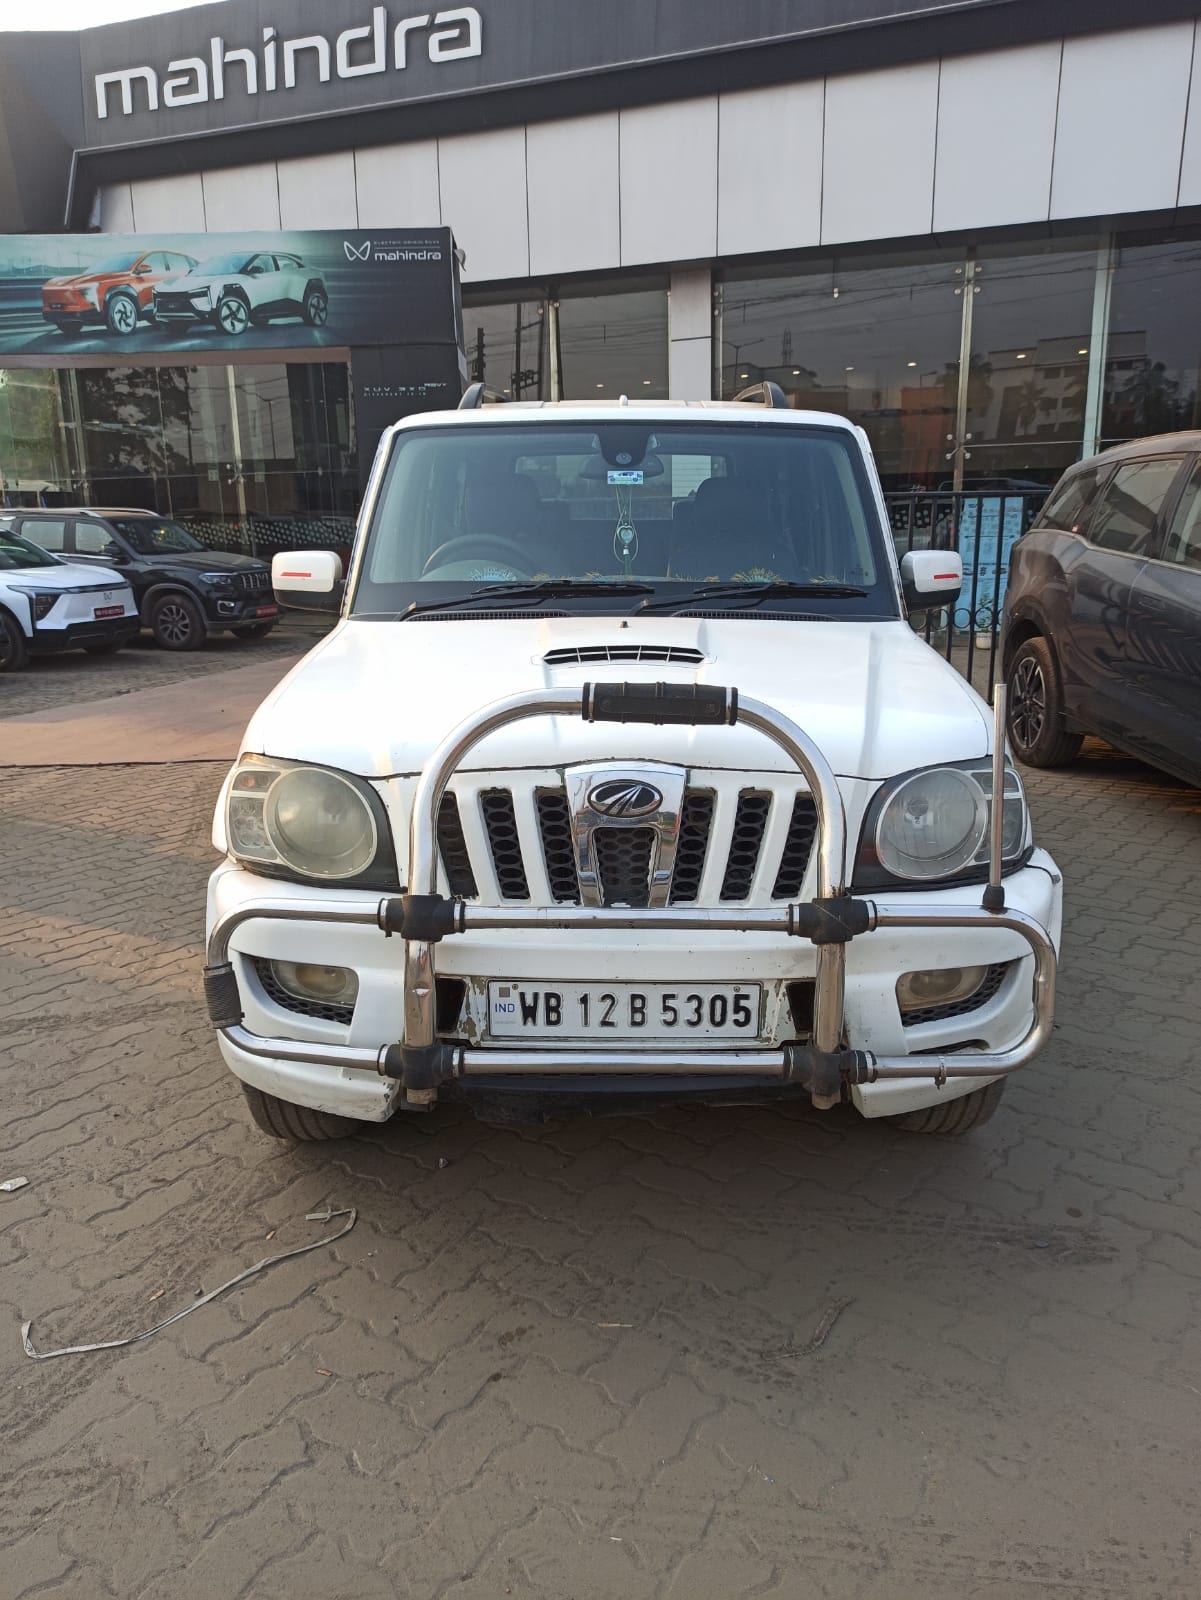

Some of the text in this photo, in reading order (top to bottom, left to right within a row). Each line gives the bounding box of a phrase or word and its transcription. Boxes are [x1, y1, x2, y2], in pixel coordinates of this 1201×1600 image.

[94, 5, 483, 119] mahindra
[374, 250, 442, 261] mahindra
[494, 1003, 516, 1013] IND
[518, 991, 751, 1028] WB 12 B 5305
